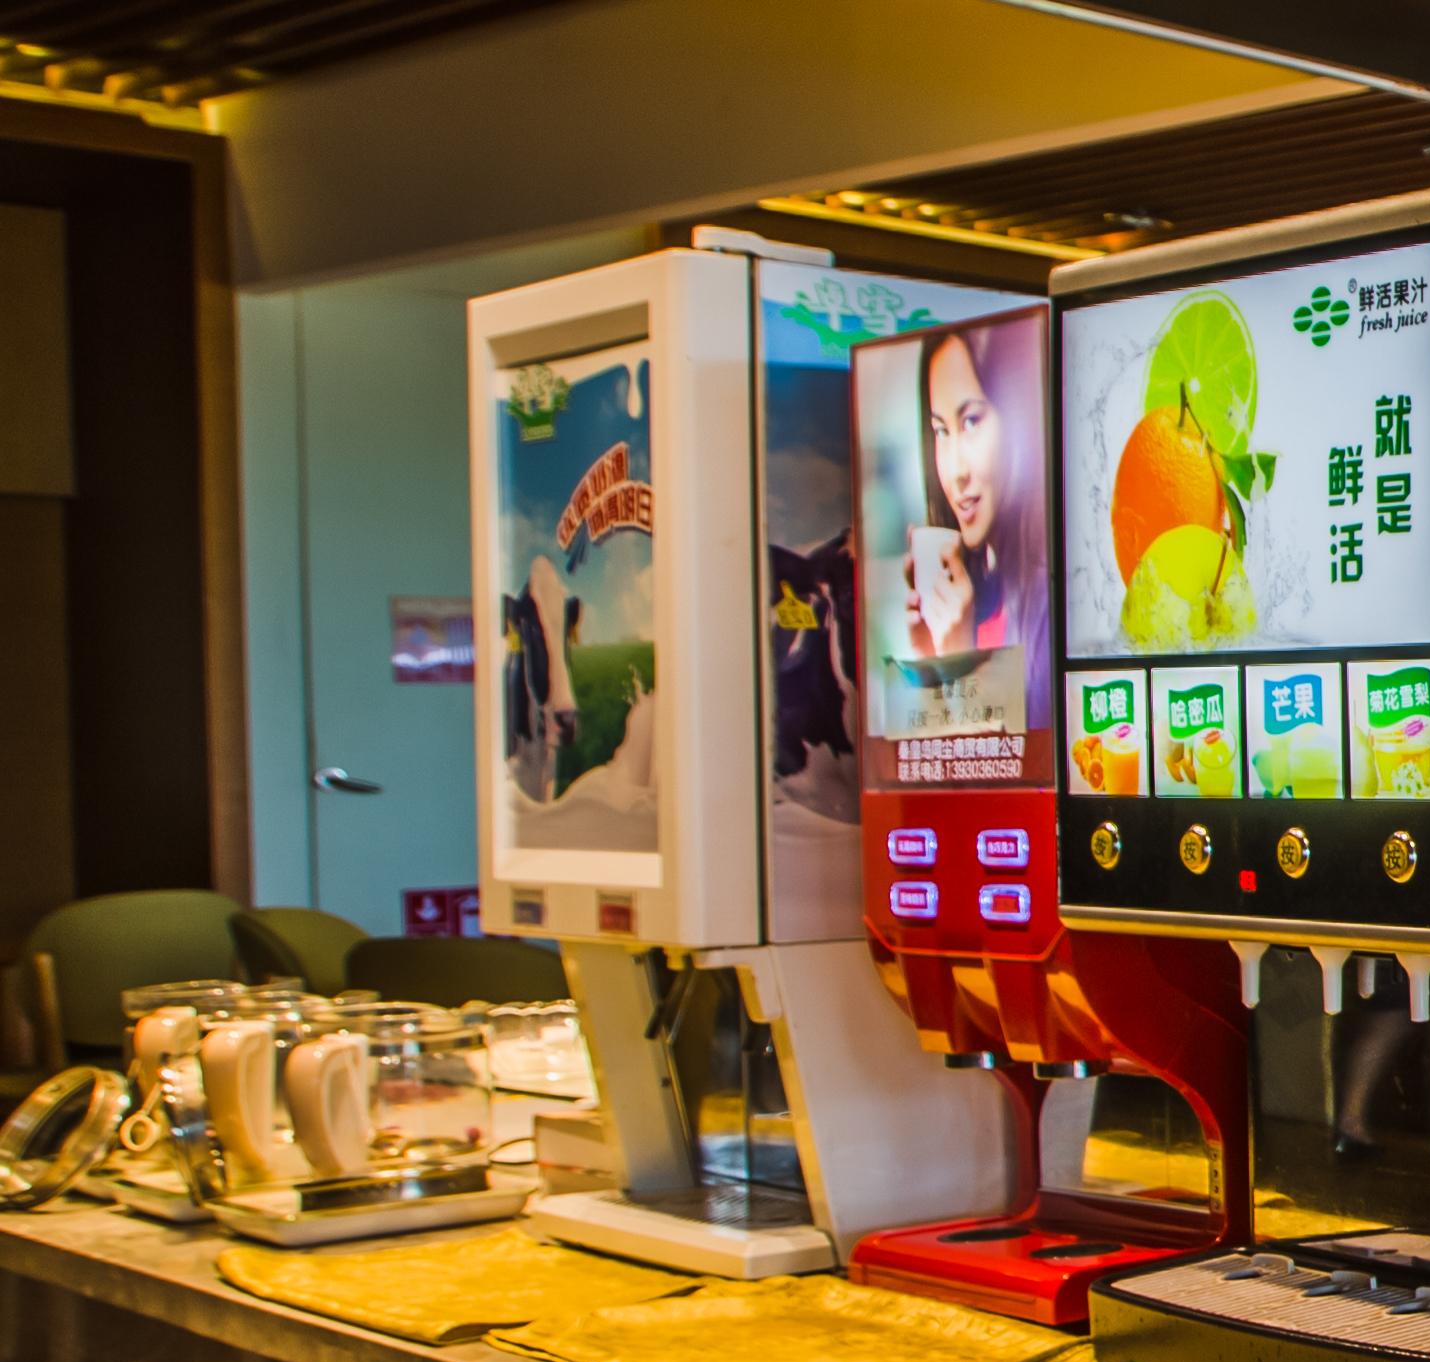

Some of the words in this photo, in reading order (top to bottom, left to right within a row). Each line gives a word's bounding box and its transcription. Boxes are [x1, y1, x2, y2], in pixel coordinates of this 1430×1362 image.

[1359, 276, 1428, 312] 鲜活果汁
[1358, 312, 1393, 339] fresh
[1394, 308, 1428, 333] juice
[1375, 394, 1413, 535] 就是
[1328, 445, 1365, 583] 鲜活
[1090, 688, 1128, 722] 柳橙
[1170, 694, 1223, 728] 哈密瓜
[1271, 683, 1316, 722] 芒果
[1369, 682, 1430, 713] 菊花雪梨
[1094, 837, 1107, 857] 按
[1184, 840, 1197, 861] 按
[1281, 842, 1295, 864] 按
[1384, 845, 1401, 870] 按
